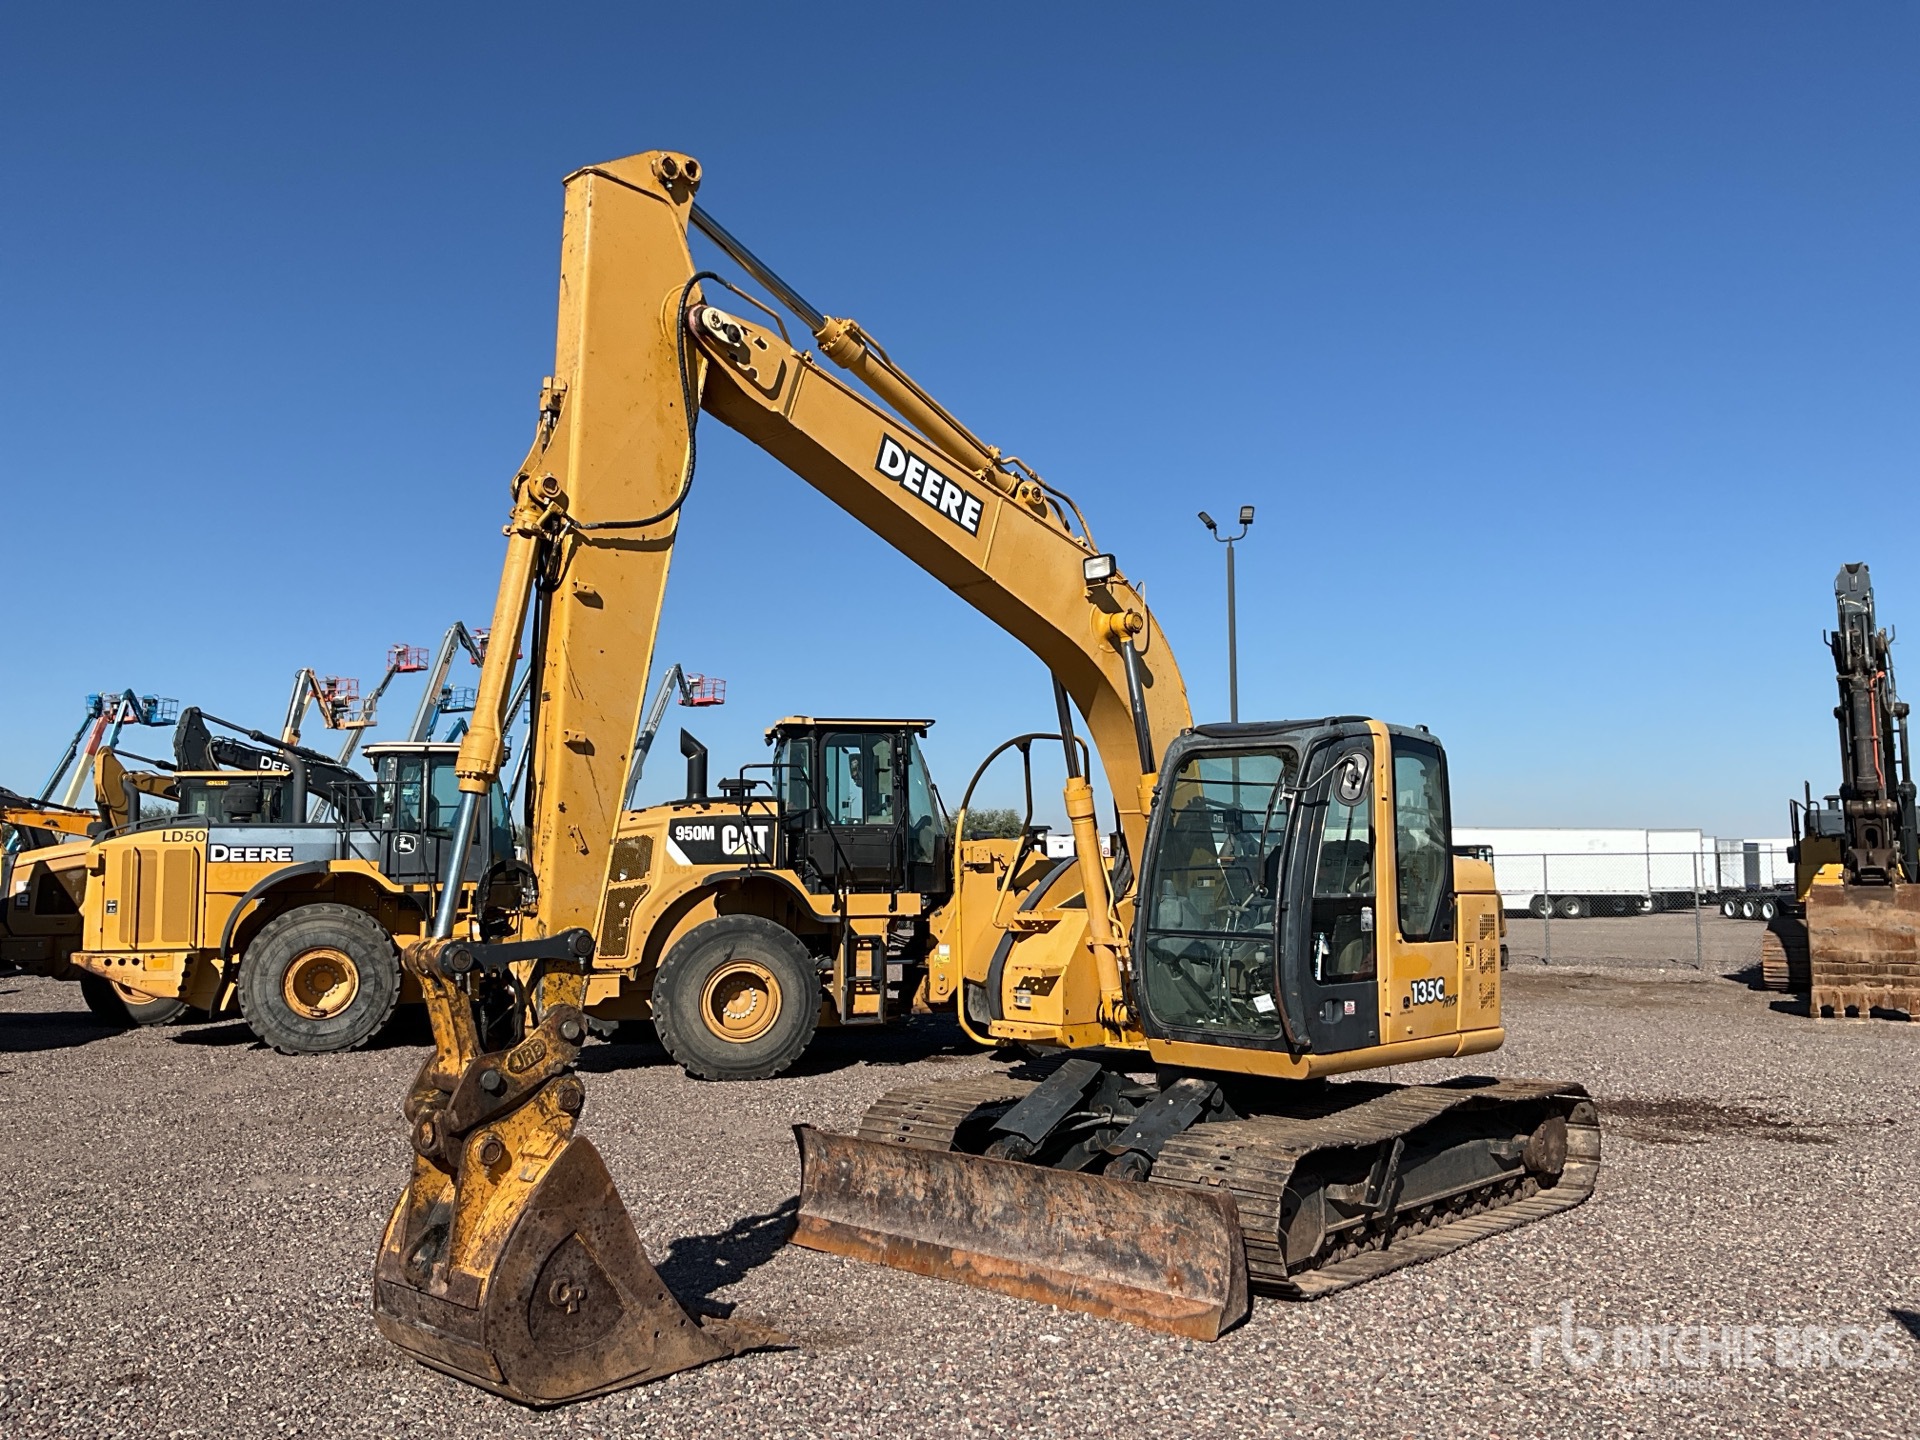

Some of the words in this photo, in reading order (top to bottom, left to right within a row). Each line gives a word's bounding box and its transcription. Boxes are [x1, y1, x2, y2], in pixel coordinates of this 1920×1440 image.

[879, 438, 982, 533] DEERE
[162, 830, 206, 843] LD50
[675, 825, 715, 841] 950M
[722, 825, 769, 855] CAT
[209, 844, 293, 863] DEERE
[1411, 978, 1445, 1005] 135C
